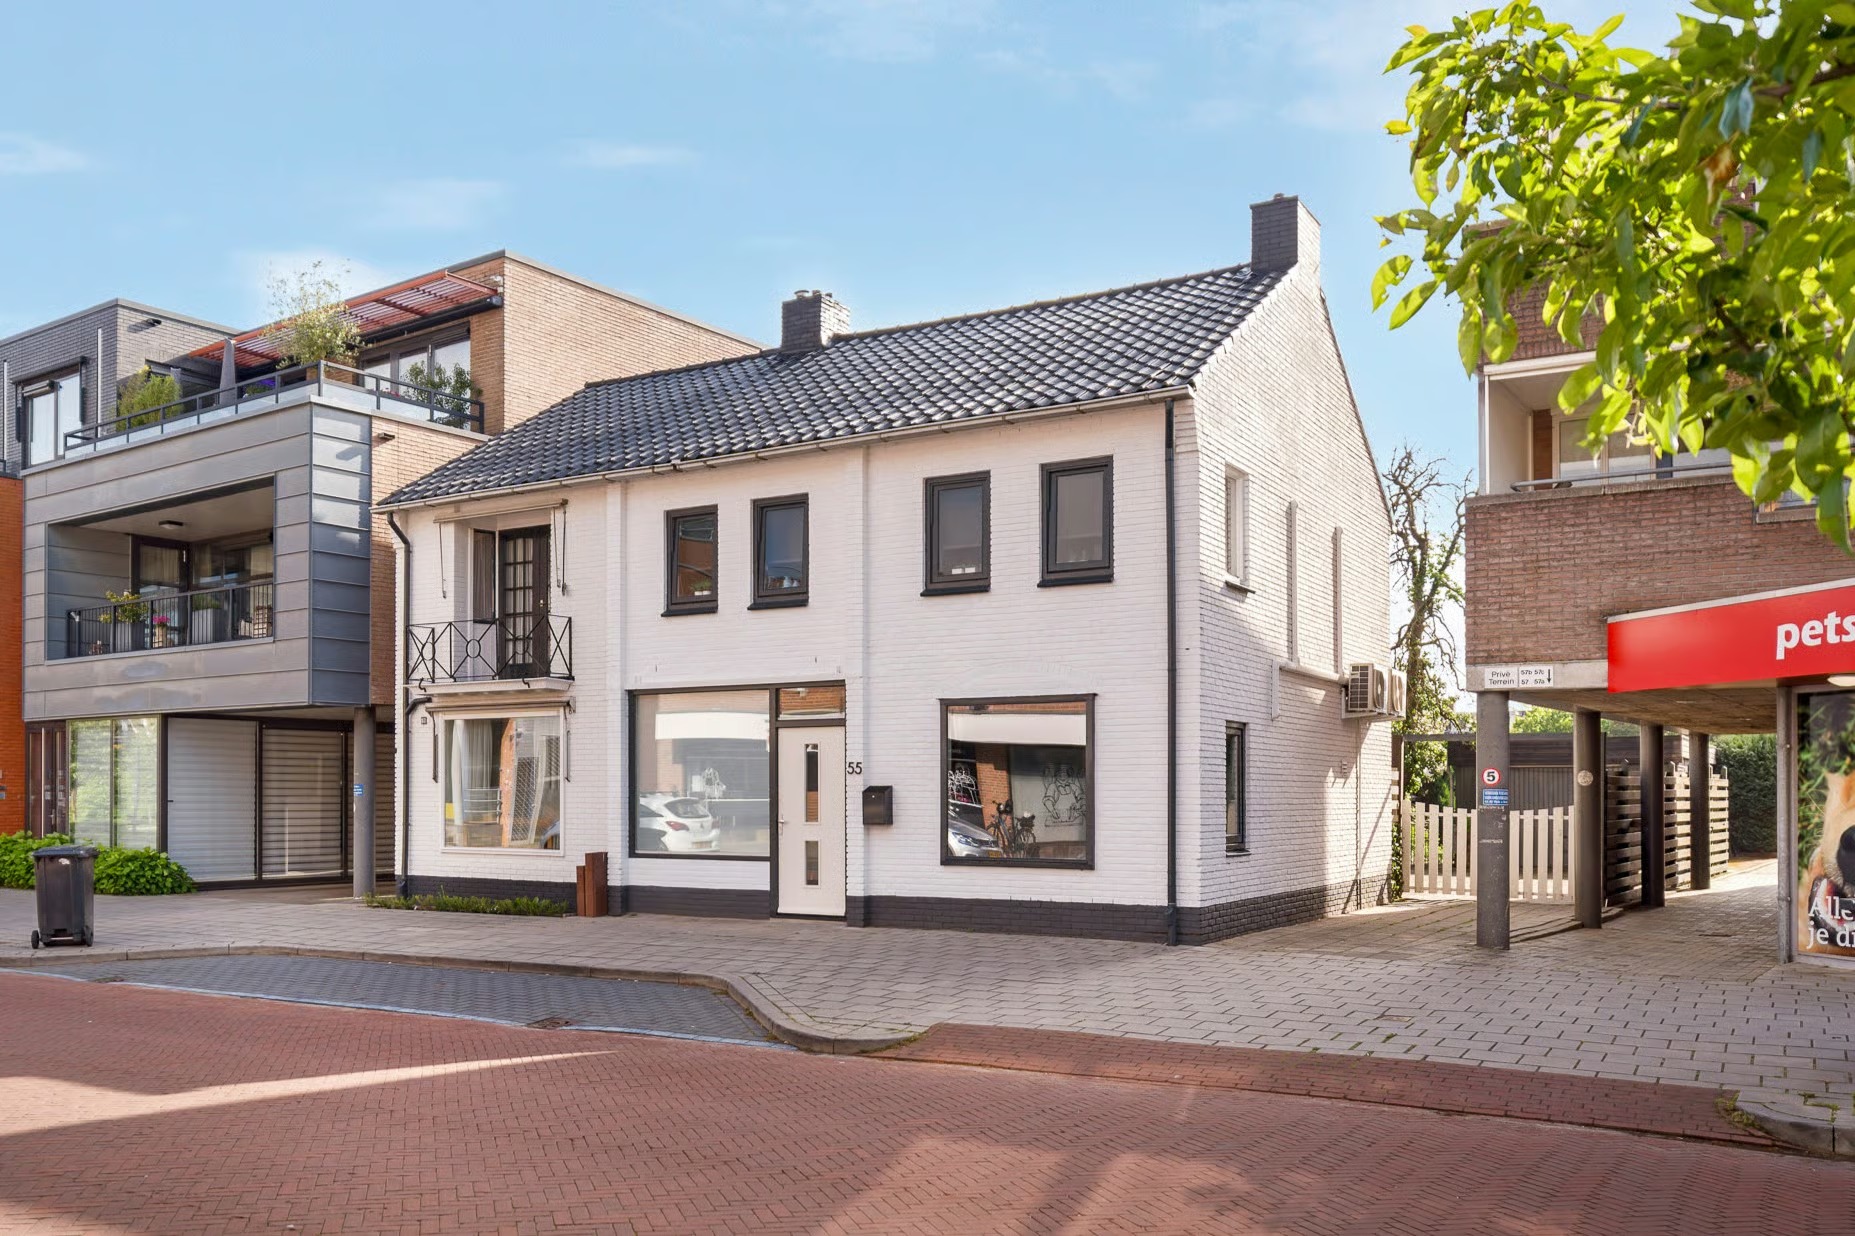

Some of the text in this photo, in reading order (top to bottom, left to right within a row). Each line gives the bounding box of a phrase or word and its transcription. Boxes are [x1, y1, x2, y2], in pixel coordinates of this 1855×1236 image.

[1776, 610, 1855, 661] pets
[847, 761, 862, 775] 55
[1487, 771, 1496, 782] 5
[1808, 896, 1854, 920] Alle
[1806, 920, 1829, 949] je
